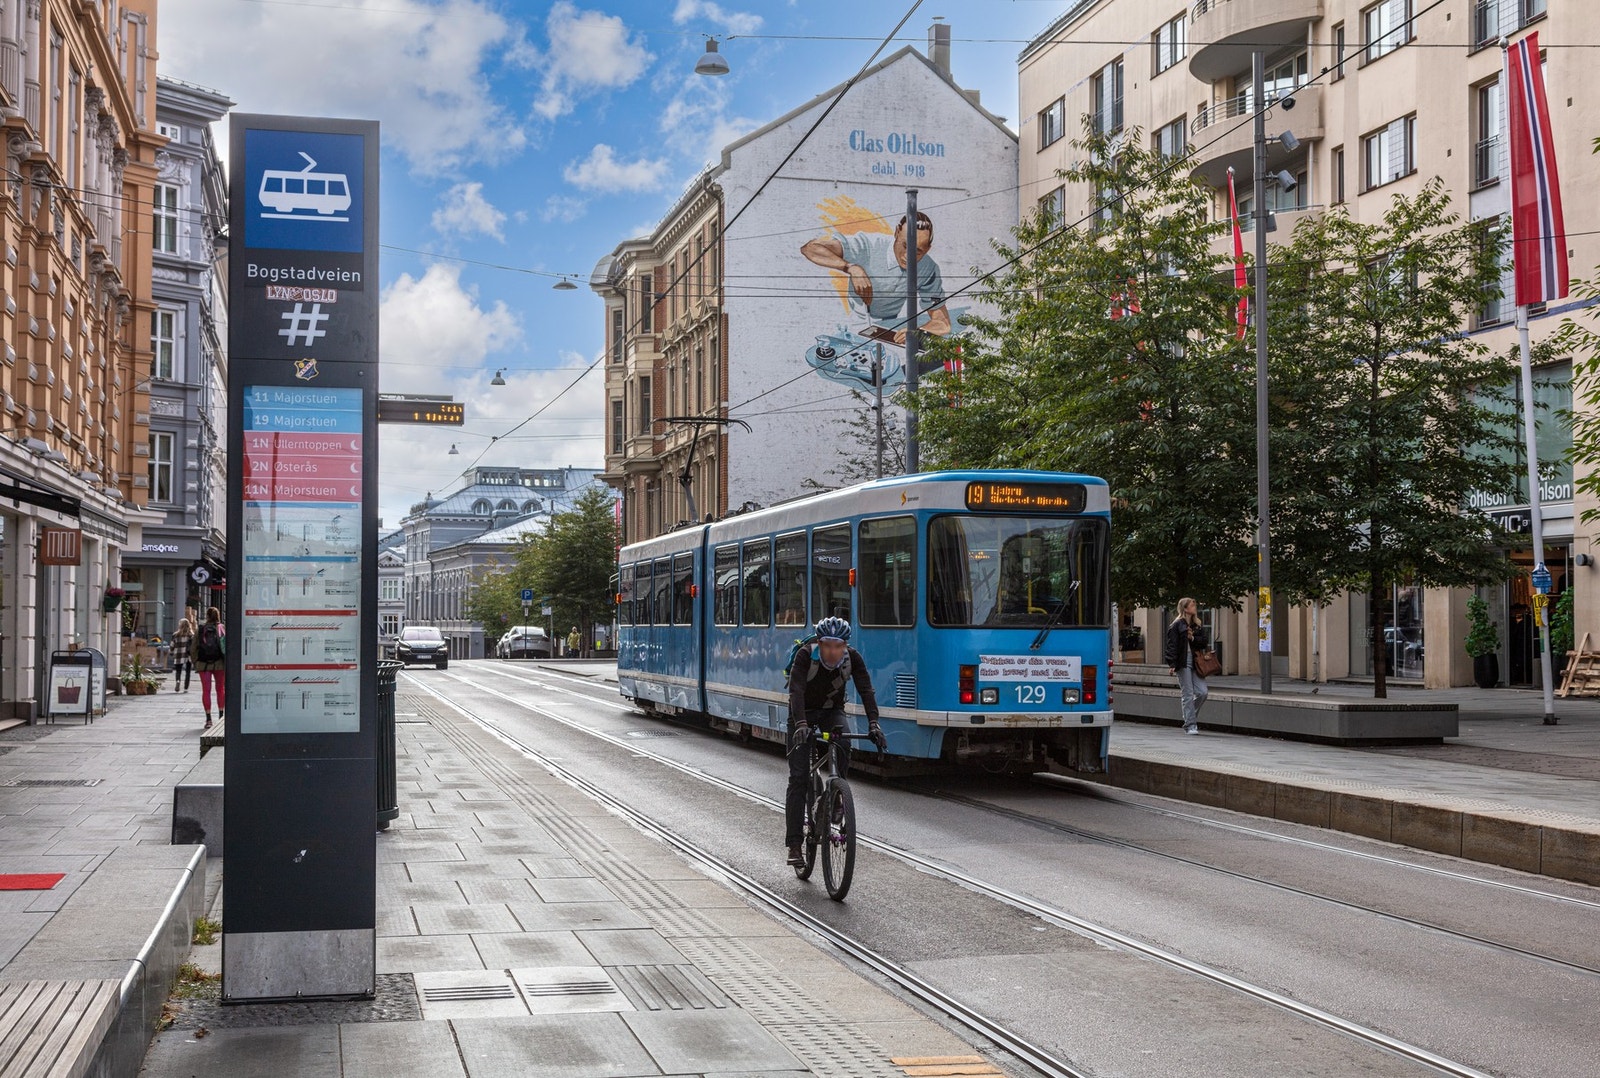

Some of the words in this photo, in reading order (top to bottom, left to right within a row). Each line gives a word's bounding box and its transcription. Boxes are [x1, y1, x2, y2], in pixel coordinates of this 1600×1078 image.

[849, 129, 883, 153] Clas
[887, 132, 945, 157] Ohlson
[903, 164, 926, 178] 1918
[247, 263, 361, 283] Bogstadveien
[266, 286, 290, 300] LYN
[303, 288, 337, 303] OSLO
[254, 392, 269, 402] 11
[274, 392, 337, 405] Majorstuen
[254, 415, 269, 425] 19
[274, 415, 337, 428] Majorstuen
[252, 438, 269, 449] 1N
[274, 438, 342, 451] Ullerntoppen
[252, 461, 269, 472] 2N
[274, 461, 318, 472] Østerås
[245, 484, 269, 495] 11N
[274, 485, 337, 498] Majorstuen
[1538, 482, 1570, 501] hlson
[142, 543, 179, 553] amsonite
[1014, 685, 1046, 704] 129
